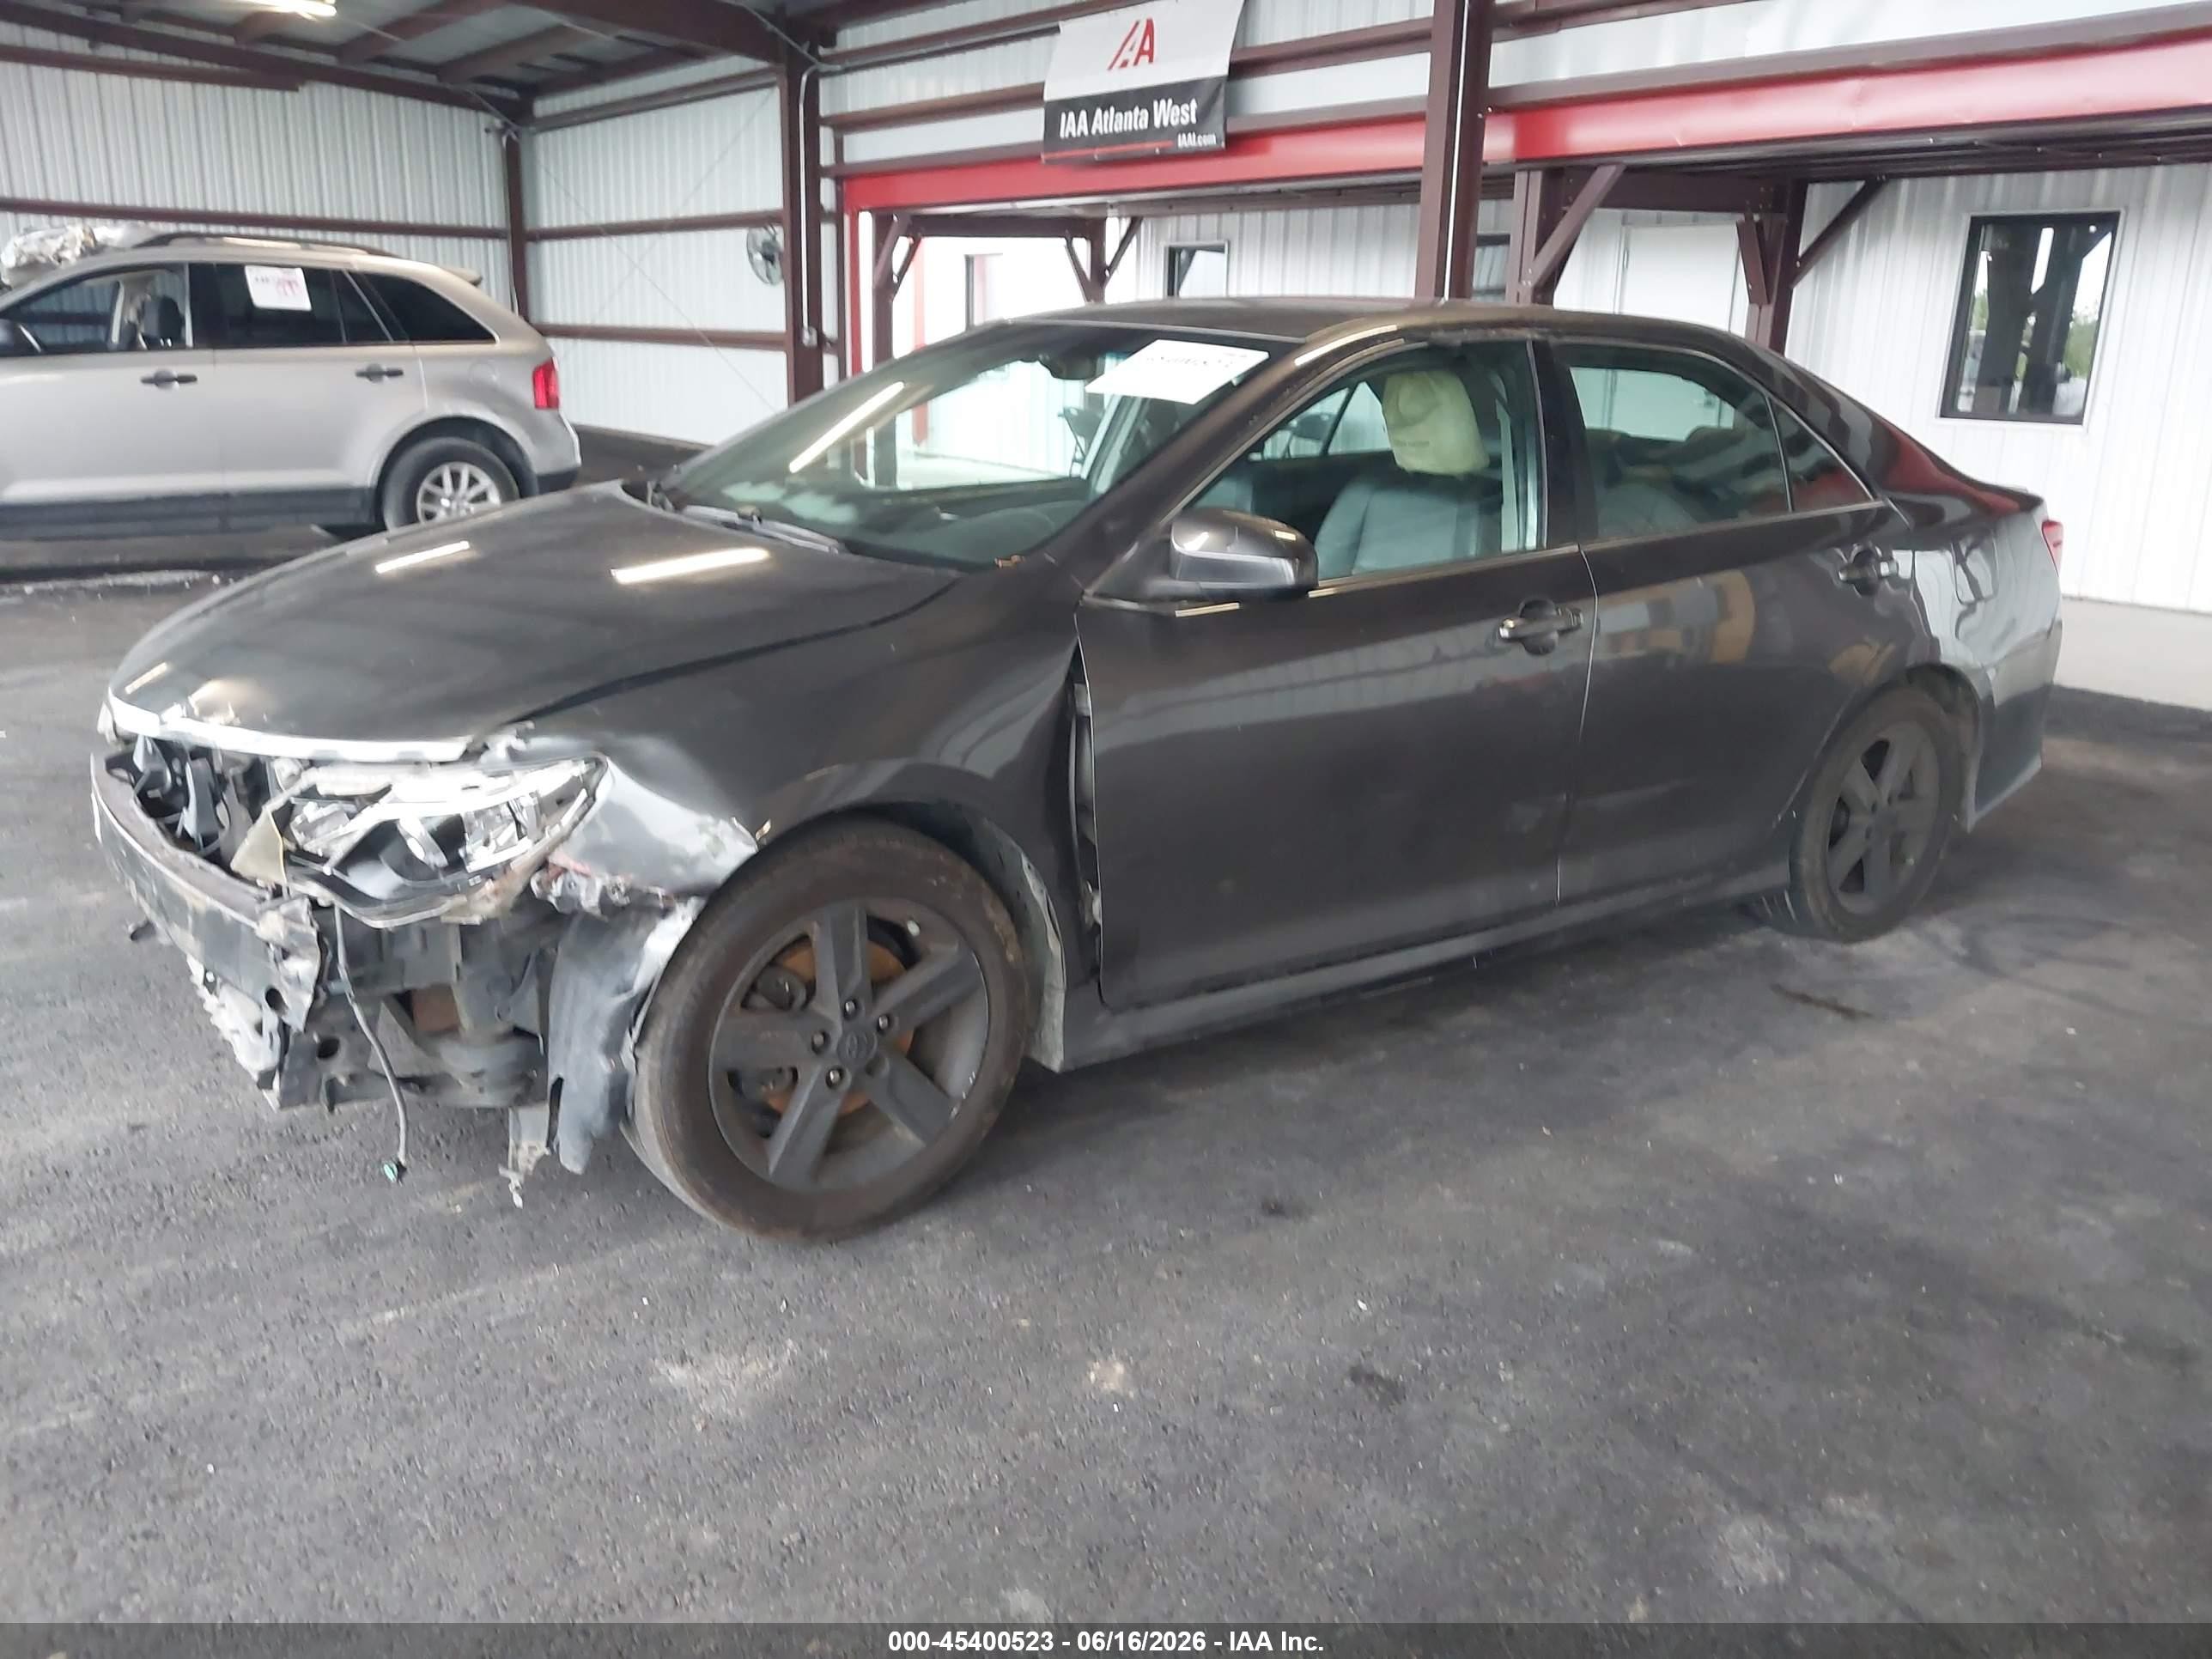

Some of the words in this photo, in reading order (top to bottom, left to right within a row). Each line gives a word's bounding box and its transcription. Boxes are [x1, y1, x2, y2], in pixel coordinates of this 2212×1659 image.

[1059, 109, 1089, 139] IAA
[1091, 105, 1150, 136] Atlanta
[1152, 97, 1198, 129] West
